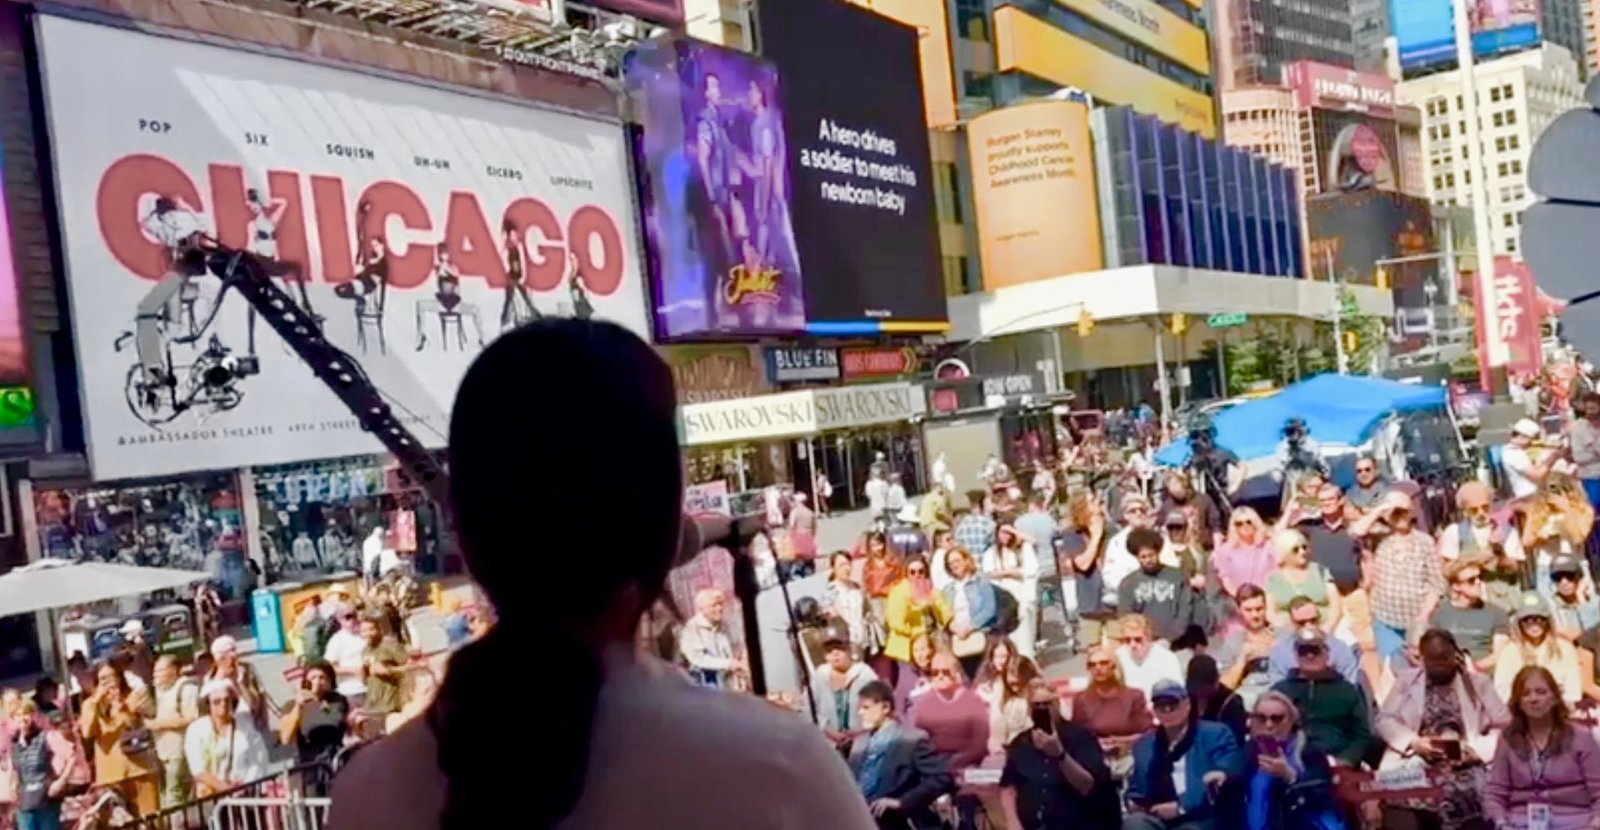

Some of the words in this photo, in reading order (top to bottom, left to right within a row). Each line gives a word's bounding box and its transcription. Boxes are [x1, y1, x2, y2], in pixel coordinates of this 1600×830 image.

[139, 119, 172, 134] POP
[245, 132, 269, 147] SIX
[819, 118, 830, 140] A
[830, 121, 860, 148] hero
[860, 129, 896, 156] drives
[326, 143, 375, 160] SQUISH
[800, 148, 810, 167] a
[811, 148, 854, 174] soldier
[855, 156, 868, 177] to
[869, 162, 900, 183] meet
[899, 164, 917, 187] his
[821, 182, 876, 206] newborn
[876, 187, 906, 216] baby
[97, 155, 624, 295] CHICAGO
[1494, 274, 1523, 338] tkts
[776, 349, 811, 368] BLUE
[815, 349, 838, 366] FIN
[686, 404, 812, 434] SWAROVSKI
[815, 386, 912, 425] SWAROVSKI
[130, 430, 217, 445] AMBASSADOR
[223, 426, 274, 438] THEATRE
